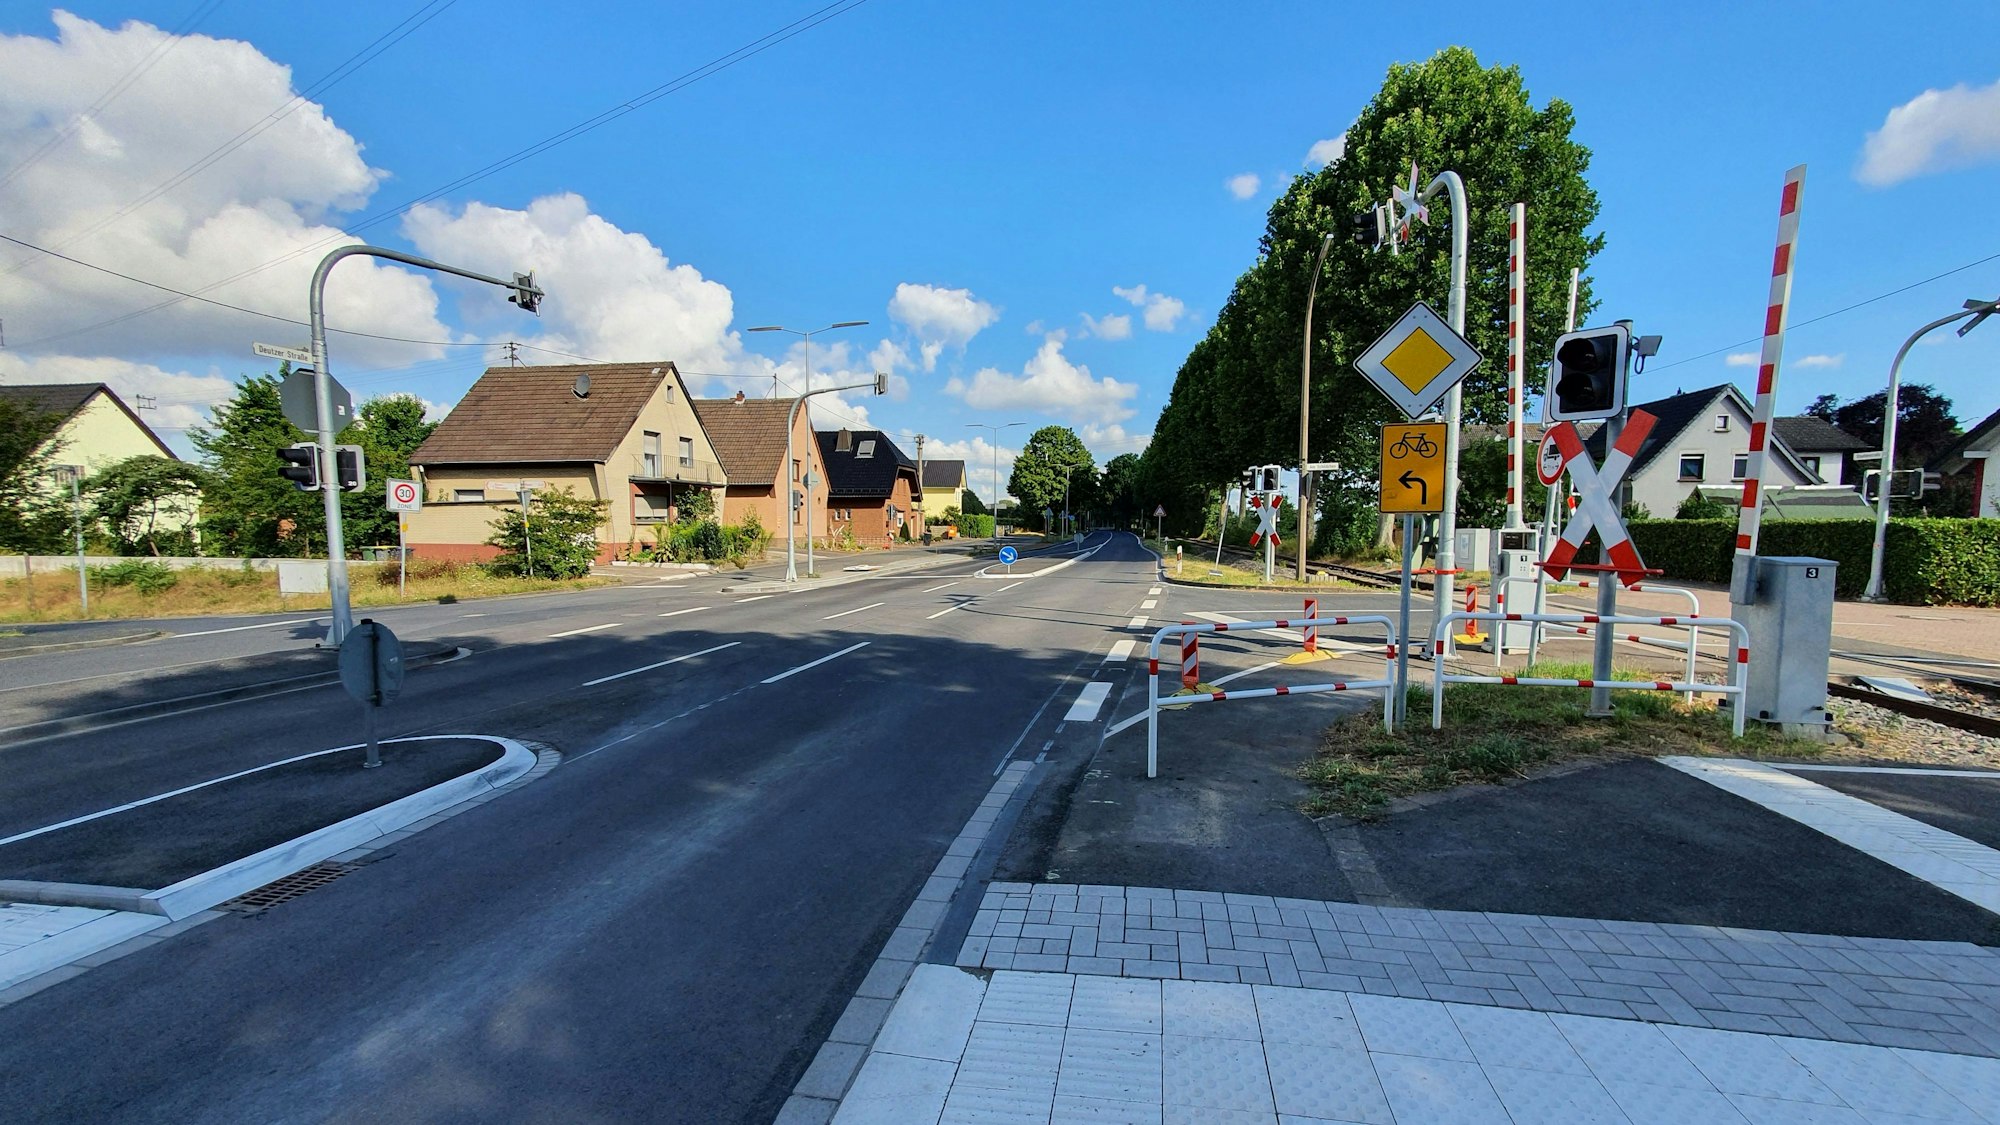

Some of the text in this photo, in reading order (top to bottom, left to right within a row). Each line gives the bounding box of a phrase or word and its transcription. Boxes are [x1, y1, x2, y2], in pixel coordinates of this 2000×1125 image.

[258, 345, 284, 357] Deutzer
[287, 351, 308, 361] Straße
[399, 489, 411, 498] 30
[1808, 568, 1816, 578] 3
